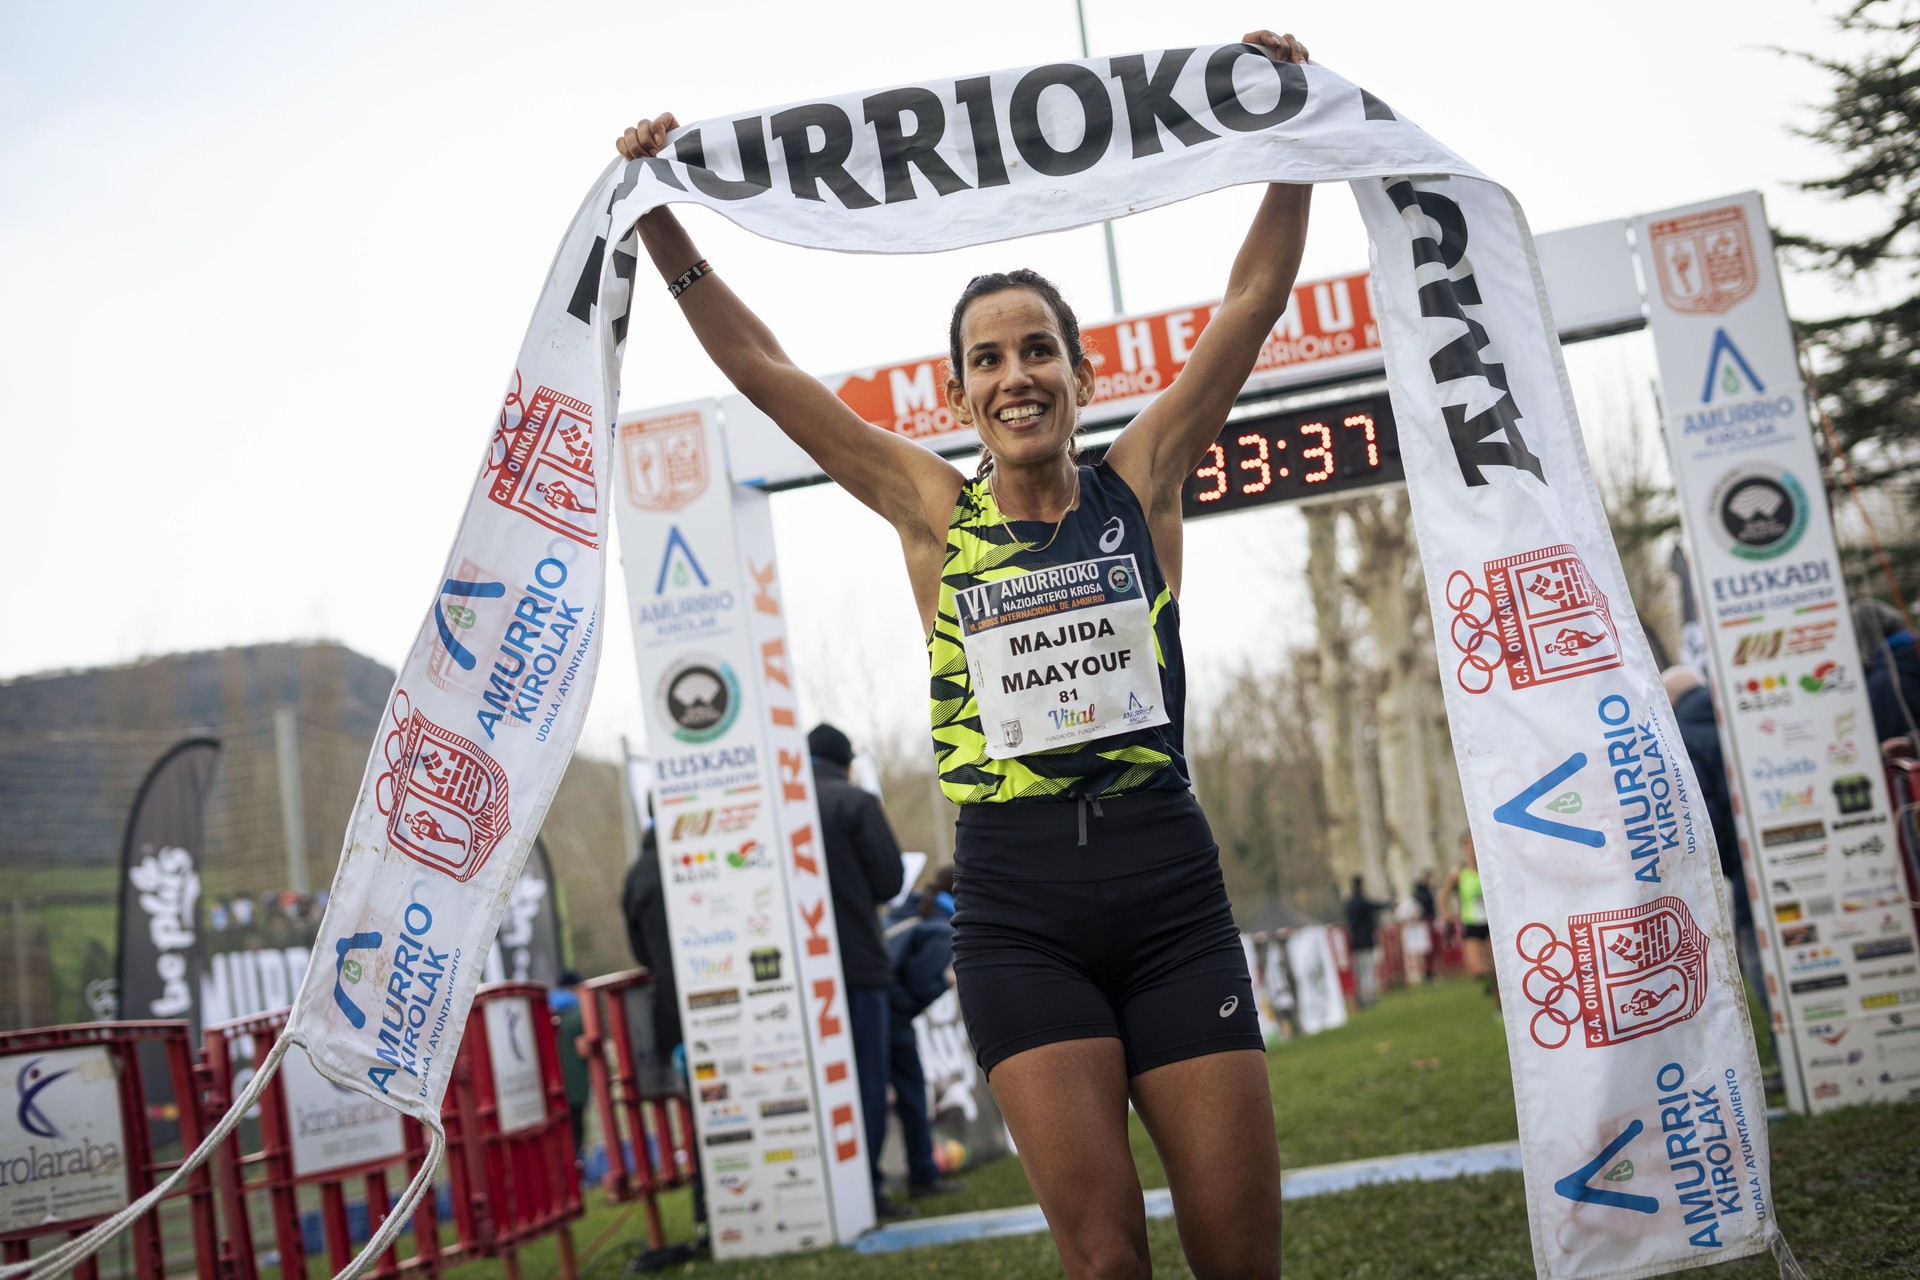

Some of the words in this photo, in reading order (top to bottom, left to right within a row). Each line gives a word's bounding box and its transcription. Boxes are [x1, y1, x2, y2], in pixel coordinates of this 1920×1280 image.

[508, 398, 550, 473] OINKARIAK
[1196, 413, 1380, 503] 33:37
[963, 586, 999, 621] VI.
[1000, 562, 1100, 600] AMURRIOKO
[1002, 588, 1068, 613] NAZIOARTEKO
[1070, 582, 1104, 598] KROSA
[1711, 559, 1831, 599] EUSKADI
[978, 616, 999, 631] CROSS
[1000, 604, 1059, 624] INTERNACIONAL
[1059, 600, 1071, 611] DE
[1071, 594, 1106, 608] AMURRIO
[1009, 617, 1116, 657] MAJIDA
[1490, 571, 1523, 653] OINKARIAK
[476, 557, 568, 741] AMURRIO
[510, 598, 585, 724] KIROLAK
[1001, 648, 1132, 695] MAAYOUF
[1512, 656, 1531, 685] C.A.
[535, 702, 561, 743] UDALA
[1048, 703, 1096, 730] Vital
[1058, 688, 1079, 704] 81
[656, 743, 758, 781] EUSKADI
[1597, 693, 1662, 884] AMURRIO
[1637, 719, 1680, 852] KIROLAK
[472, 800, 497, 854] AMURRIO
[1680, 811, 1697, 855] UDALA
[1572, 925, 1600, 1010] OINKARIAK
[1672, 928, 1701, 982] AMURRIO
[367, 902, 433, 1096] AMURRIO
[400, 944, 450, 1078] KIROLAK
[431, 947, 462, 1050] AYUNTAMIENTO
[1587, 1013, 1605, 1044] C.A.
[1723, 1067, 1758, 1169] AYUNTAMIENTO
[0, 1136, 121, 1188] rolaraba
[1655, 1062, 1724, 1249] AMURRIO
[1690, 1083, 1745, 1217] KIROLAK
[1748, 1176, 1767, 1222] UDALA
